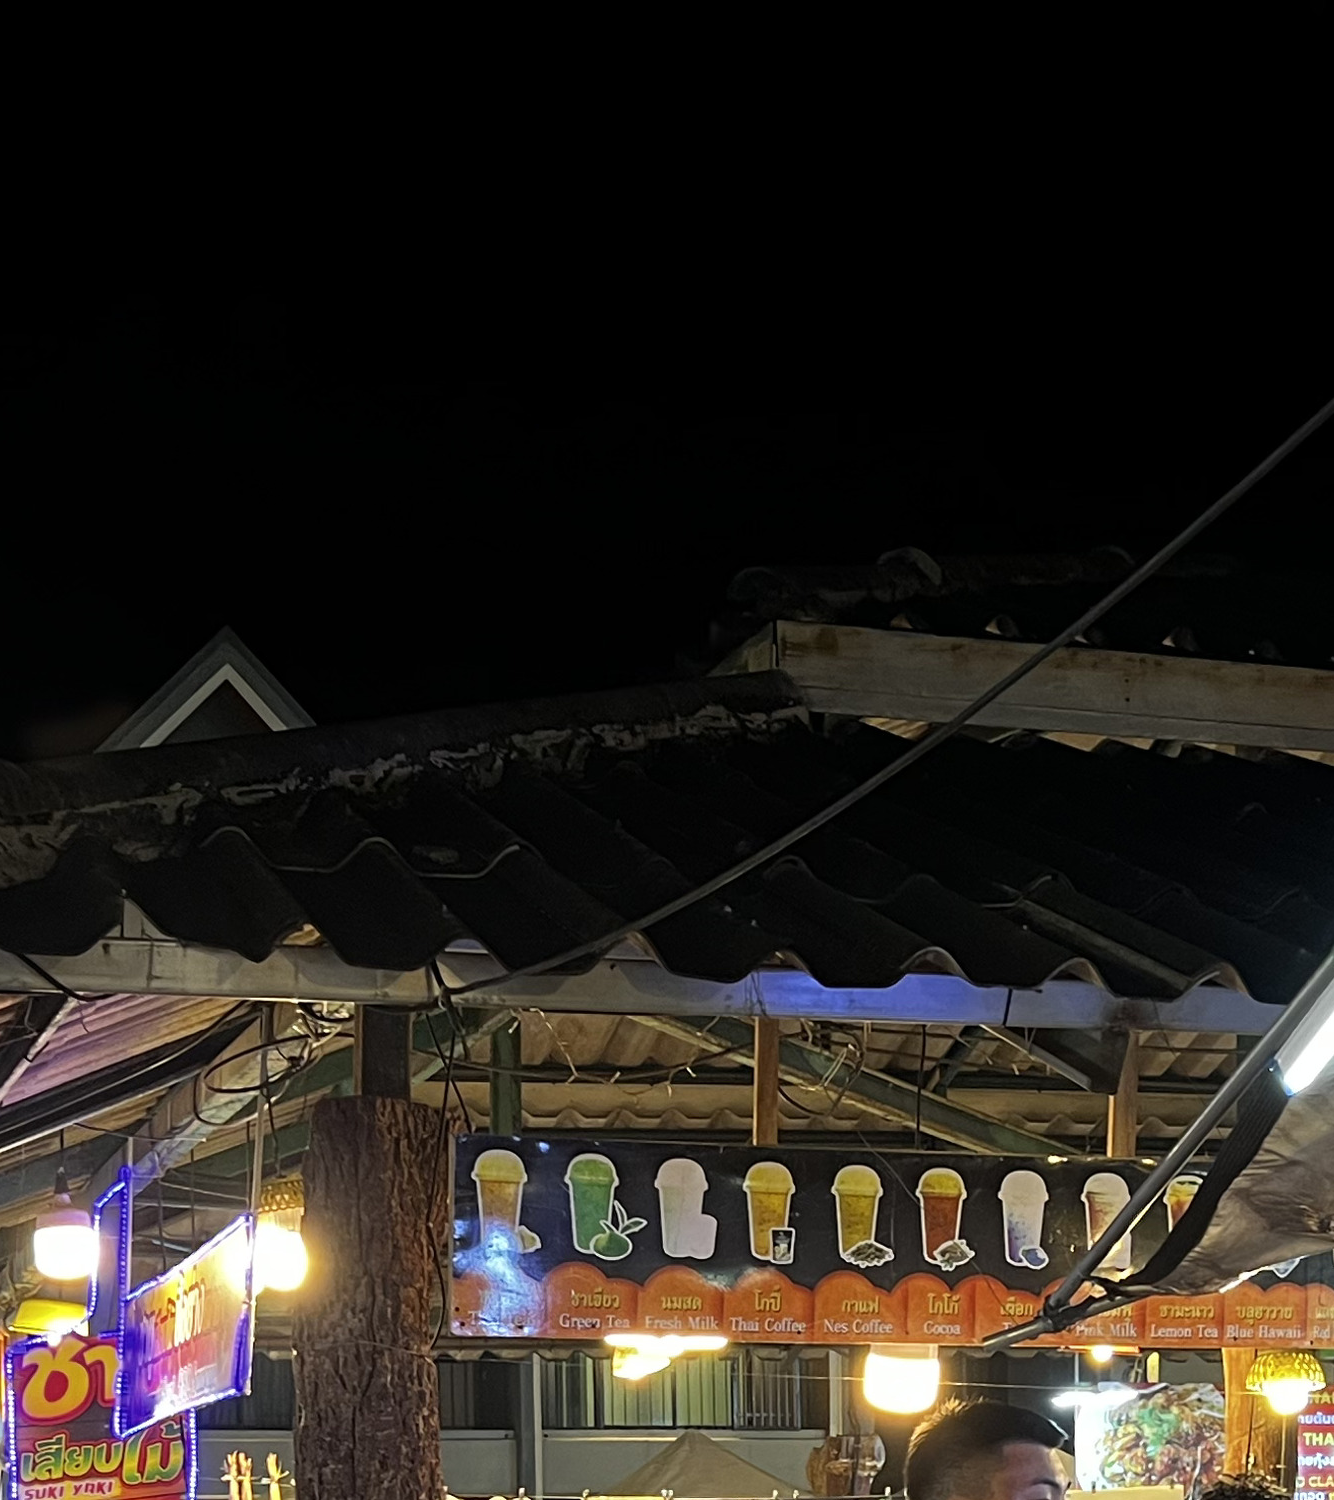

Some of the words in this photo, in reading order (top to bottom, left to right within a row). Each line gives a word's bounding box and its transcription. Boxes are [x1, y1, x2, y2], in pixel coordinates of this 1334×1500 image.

[559, 1313, 602, 1329] Green
[605, 1315, 631, 1329] Tea
[644, 1315, 685, 1330] Fresh
[688, 1315, 719, 1330] Milk
[729, 1317, 760, 1332] Thai
[765, 1318, 807, 1333] Coffee
[823, 1319, 849, 1333] Nes
[853, 1319, 894, 1335] Coffee
[923, 1320, 961, 1335] Cocoa
[1109, 1324, 1138, 1338] Milk
[1151, 1324, 1194, 1338] Lemon
[1197, 1324, 1219, 1338] Tea
[1225, 1324, 1255, 1338] Blue
[22, 1421, 185, 1485] เสียบไม้
[24, 1485, 64, 1500] SUKI
